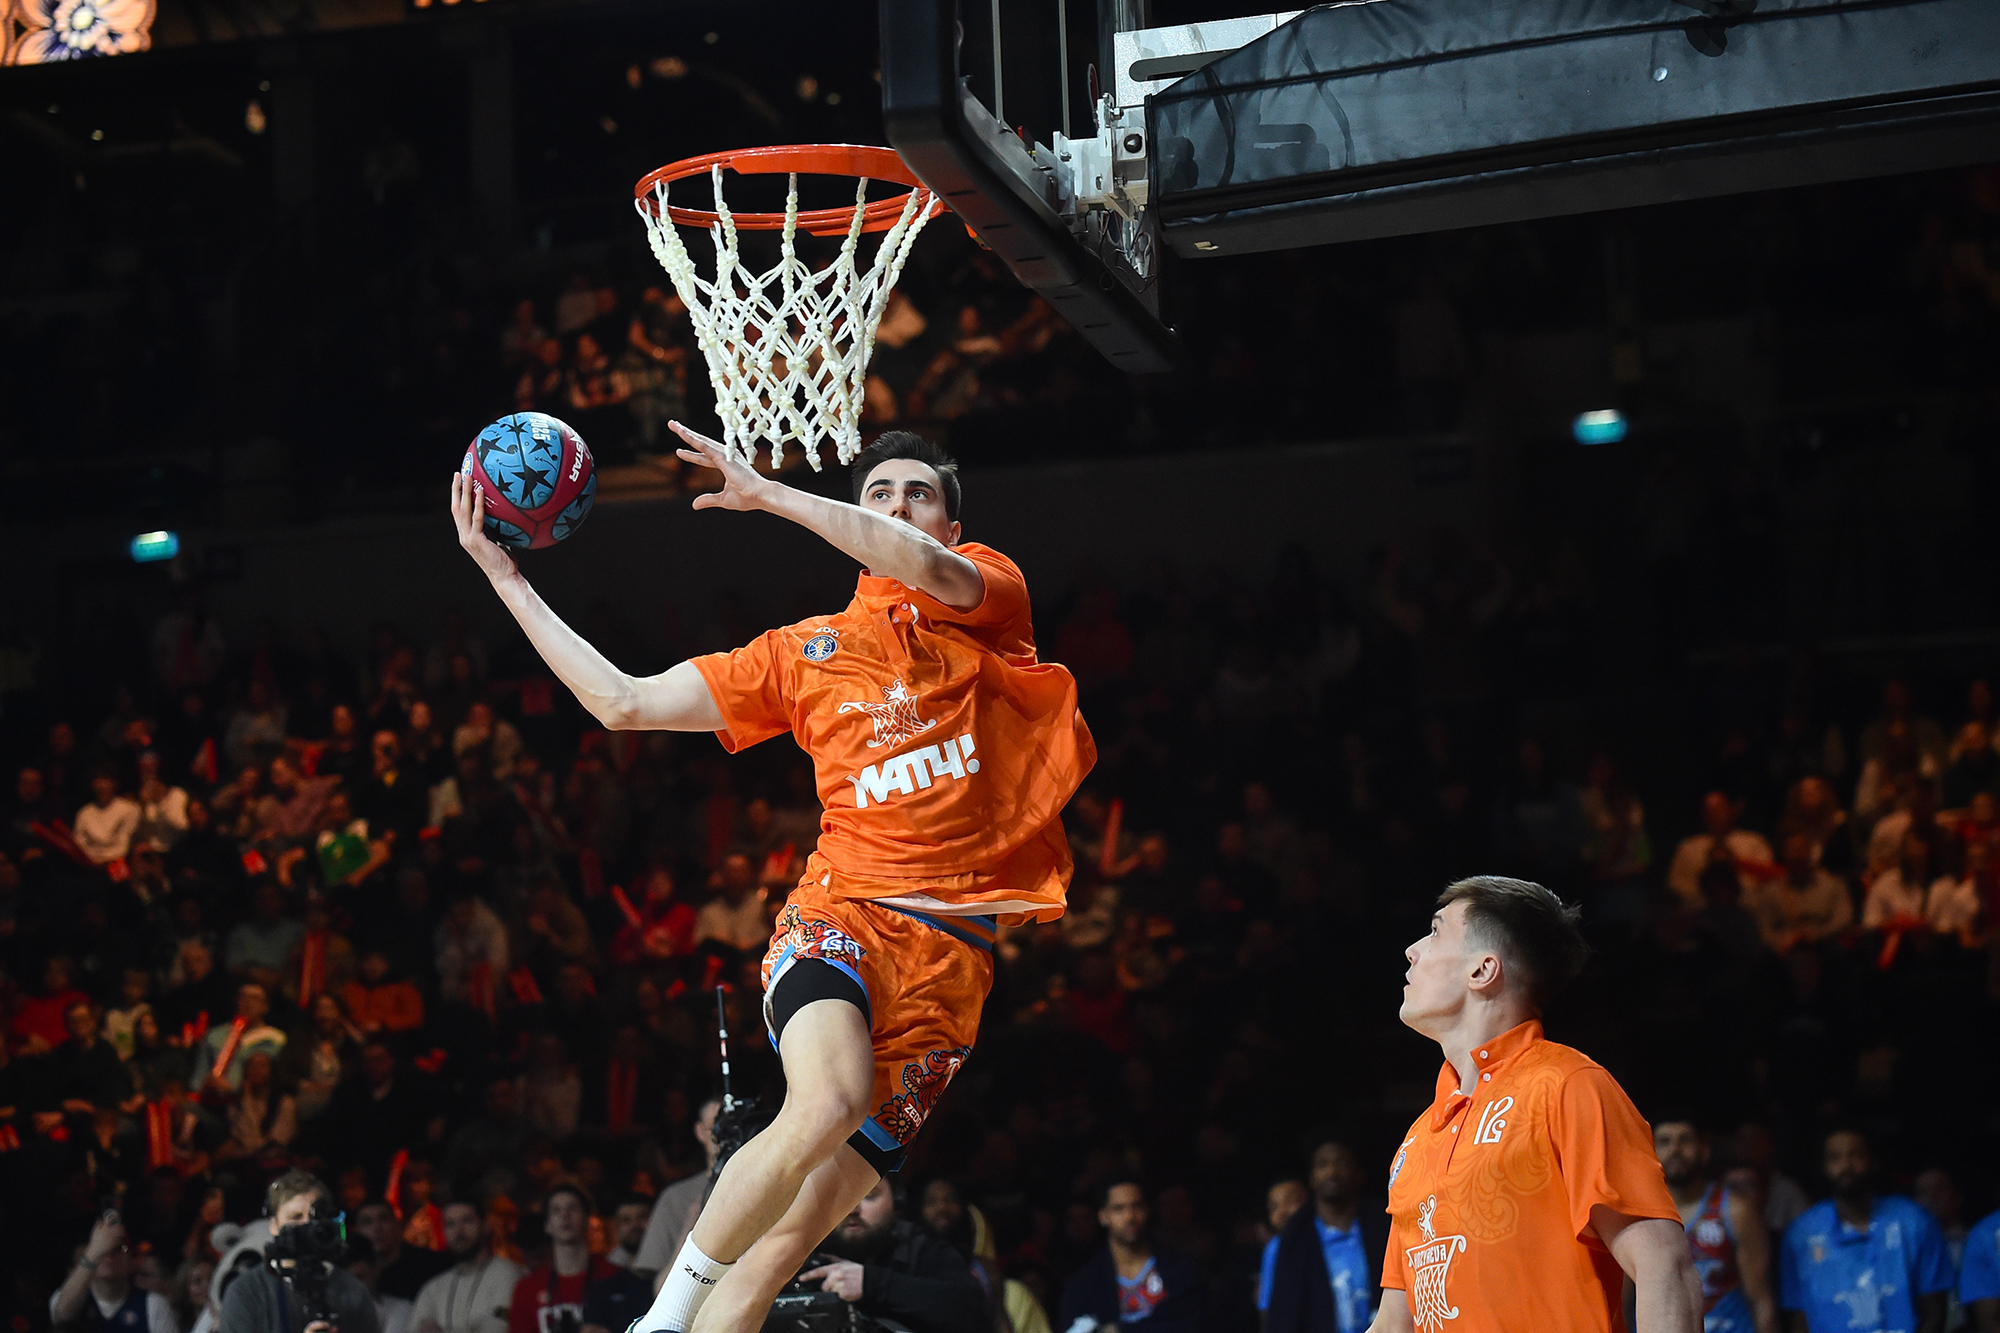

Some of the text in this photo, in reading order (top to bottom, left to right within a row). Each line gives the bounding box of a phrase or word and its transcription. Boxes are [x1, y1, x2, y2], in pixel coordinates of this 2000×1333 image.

[845, 733, 981, 809] МАТЧ!
[903, 1102, 922, 1127] ZEDO
[1473, 1095, 1514, 1145] 12
[684, 1263, 717, 1286] ZEDO
